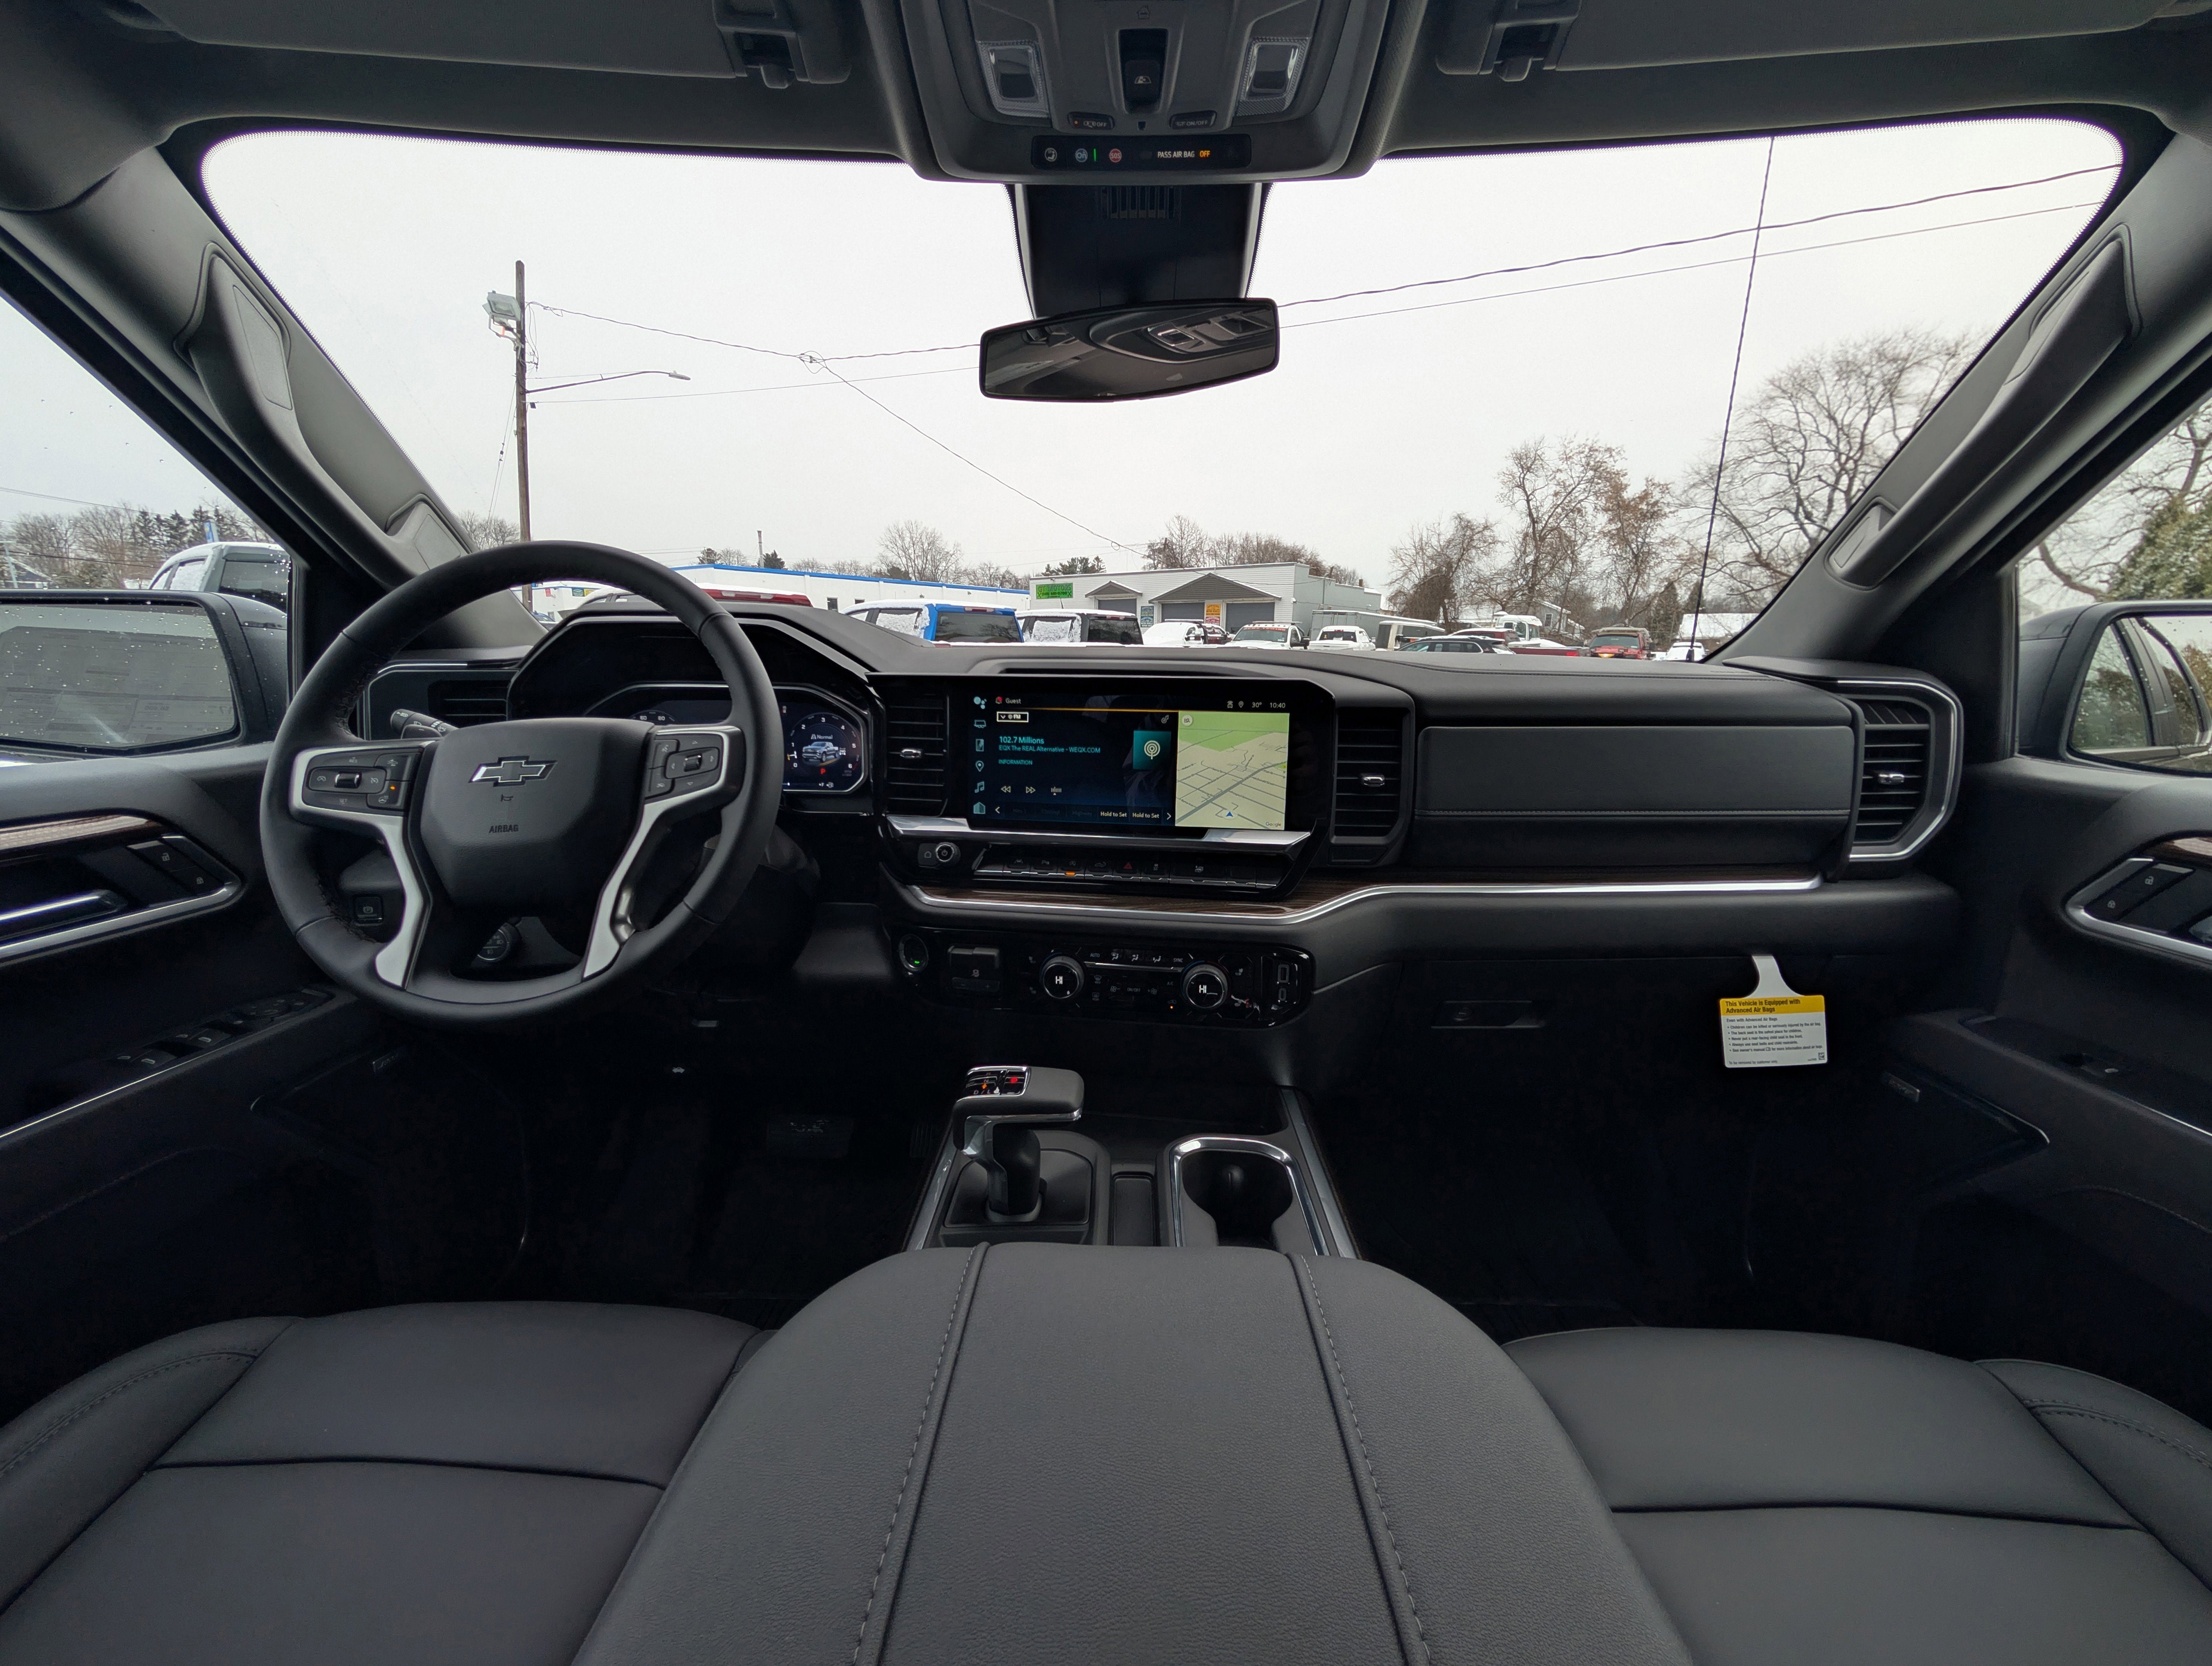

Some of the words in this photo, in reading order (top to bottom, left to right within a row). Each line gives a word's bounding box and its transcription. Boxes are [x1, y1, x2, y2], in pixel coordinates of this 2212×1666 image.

[489, 824, 519, 833] AIRBAG
[1055, 976, 1063, 985] HI
[1199, 985, 1207, 993] HI
